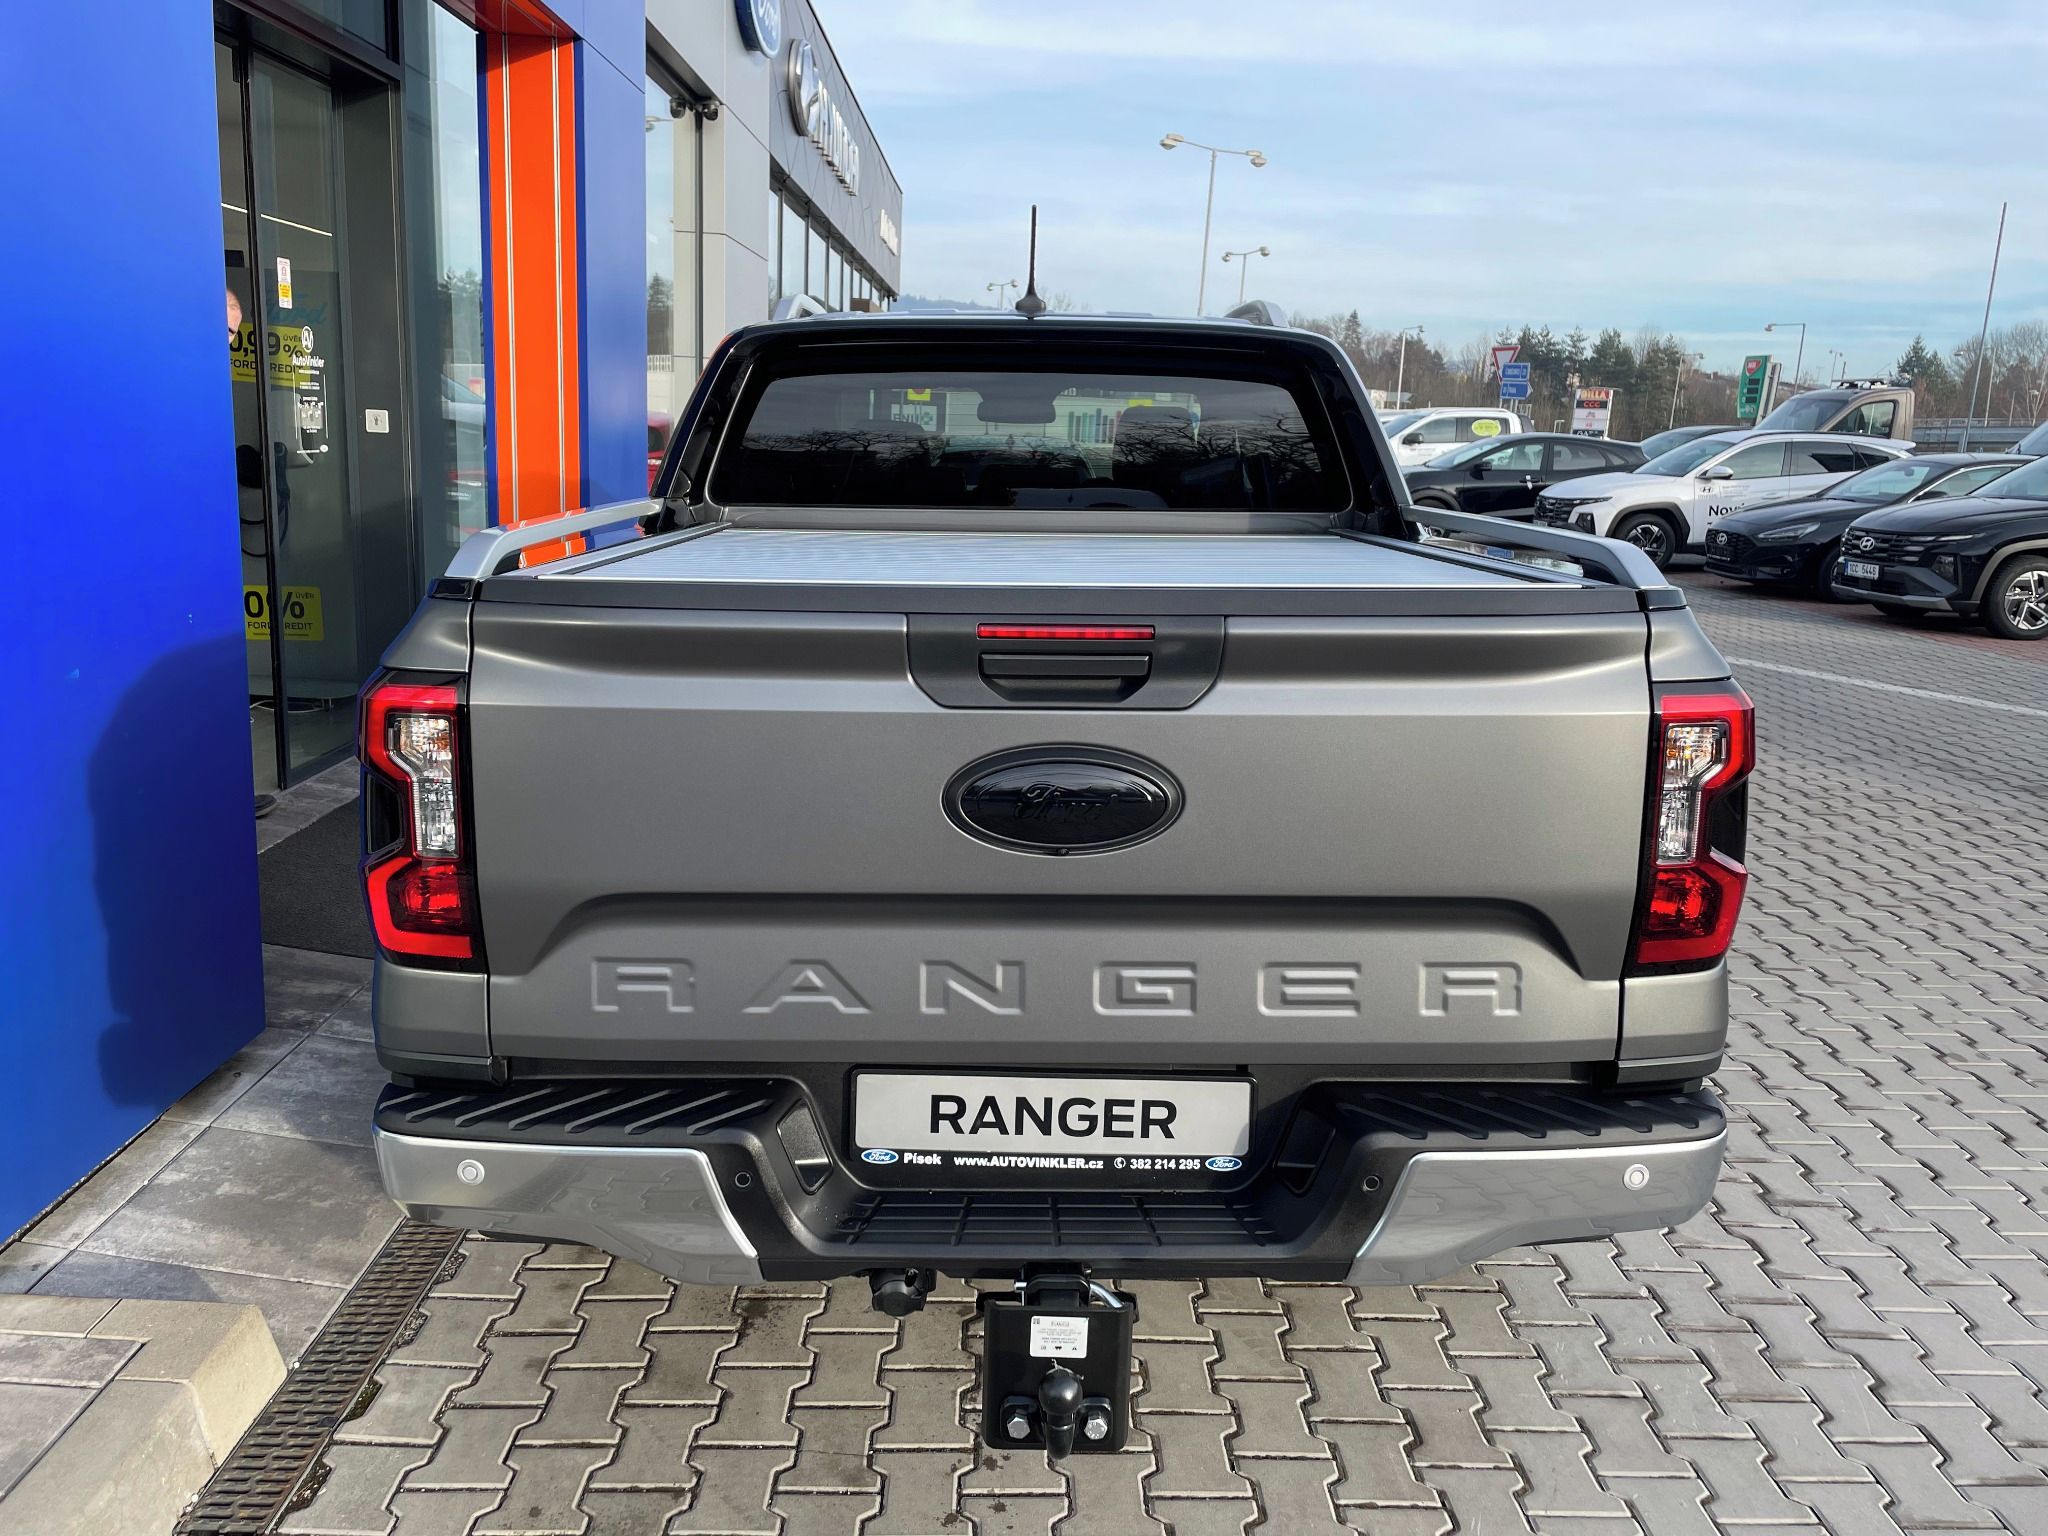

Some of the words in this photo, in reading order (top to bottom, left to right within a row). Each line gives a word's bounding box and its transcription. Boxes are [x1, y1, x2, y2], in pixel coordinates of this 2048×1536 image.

[284, 622, 313, 631] REDIT
[590, 957, 1523, 1017] RANGER
[930, 1094, 1178, 1139] RANGER
[903, 1153, 942, 1165] Písek
[953, 1155, 1104, 1169] www.AUTOVINKLER.cz
[1129, 1158, 1151, 1170] 382
[1154, 1158, 1176, 1170] 214
[1178, 1158, 1201, 1170] 295
